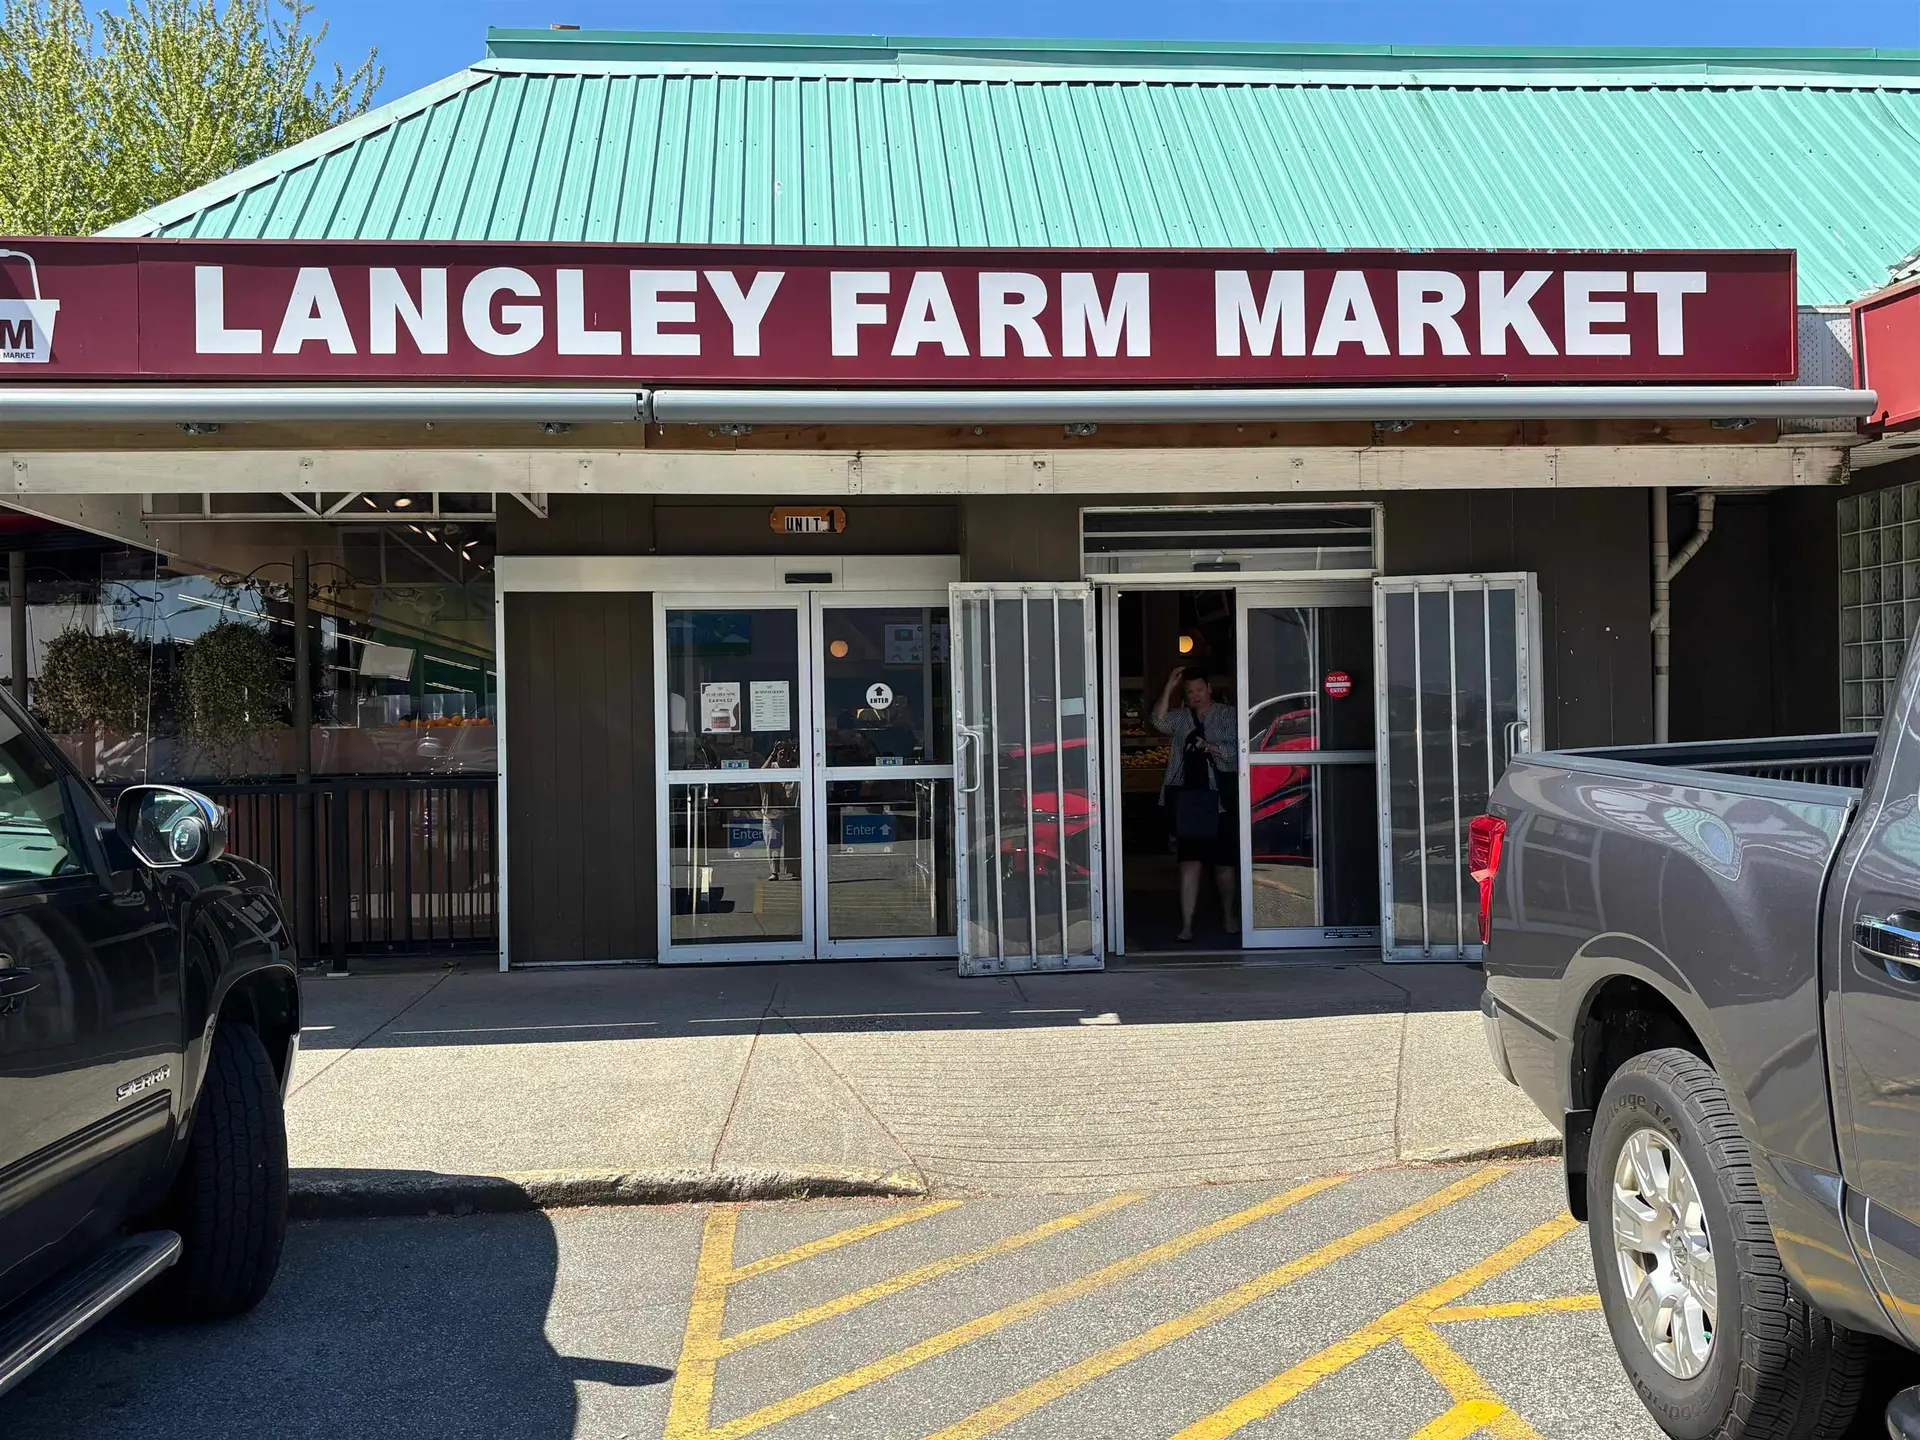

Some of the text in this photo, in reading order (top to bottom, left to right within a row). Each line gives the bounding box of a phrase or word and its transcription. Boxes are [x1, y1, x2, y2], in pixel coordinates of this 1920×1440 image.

[195, 265, 1708, 358] LANGLEY FARM MARKET
[826, 509, 837, 532] 1
[732, 829, 763, 840] Enter
[846, 824, 876, 836] Enter
[116, 1065, 171, 1102] SIERRA
